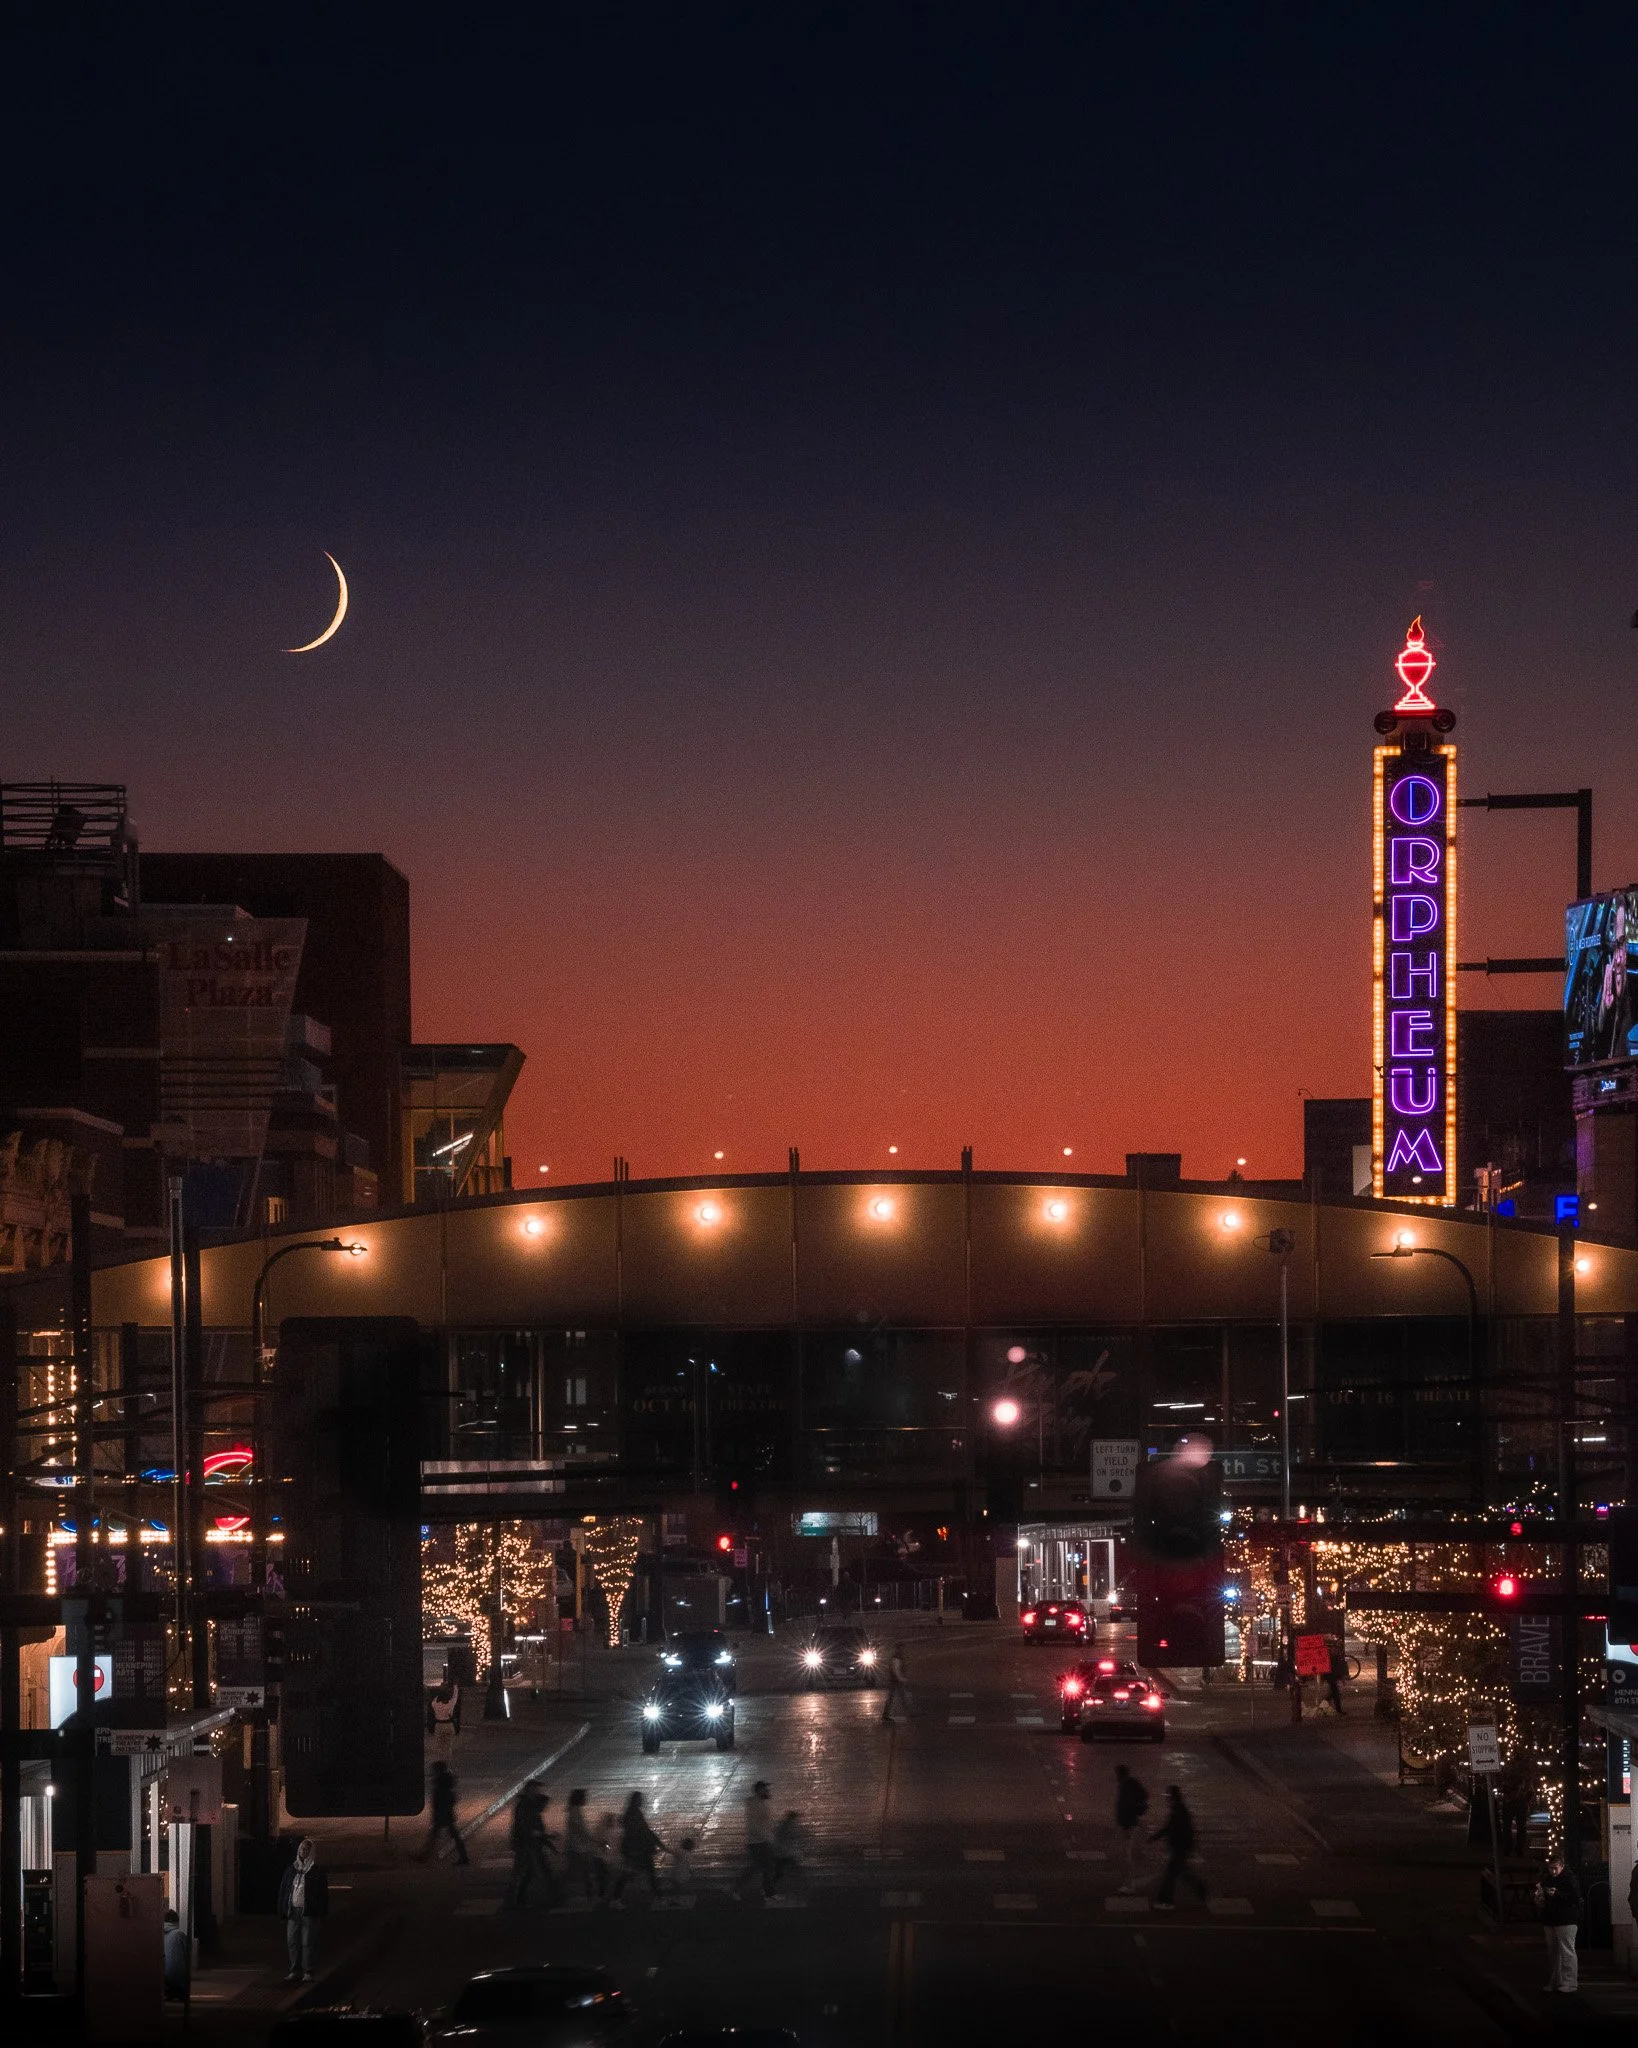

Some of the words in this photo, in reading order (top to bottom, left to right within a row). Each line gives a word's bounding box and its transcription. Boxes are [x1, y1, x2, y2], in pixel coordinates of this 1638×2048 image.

[168, 941, 291, 970] LaSalle
[1388, 775, 1443, 1172] ORPHEUM
[188, 978, 273, 1006] Plaza
[1330, 1391, 1366, 1405] OCT
[1377, 1391, 1394, 1404] 16
[633, 1399, 670, 1412] OCT
[1095, 1446, 1114, 1455] LEFT
[1116, 1446, 1136, 1455] TURN
[1104, 1456, 1128, 1466] YIELD
[1222, 1459, 1245, 1475] th
[1256, 1458, 1280, 1475] St
[1096, 1468, 1107, 1477] ON
[1110, 1468, 1135, 1477] GREEN
[1519, 1616, 1551, 1683] BRAVE
[1477, 1732, 1489, 1741] NO
[1471, 1745, 1498, 1754] STOPPING
